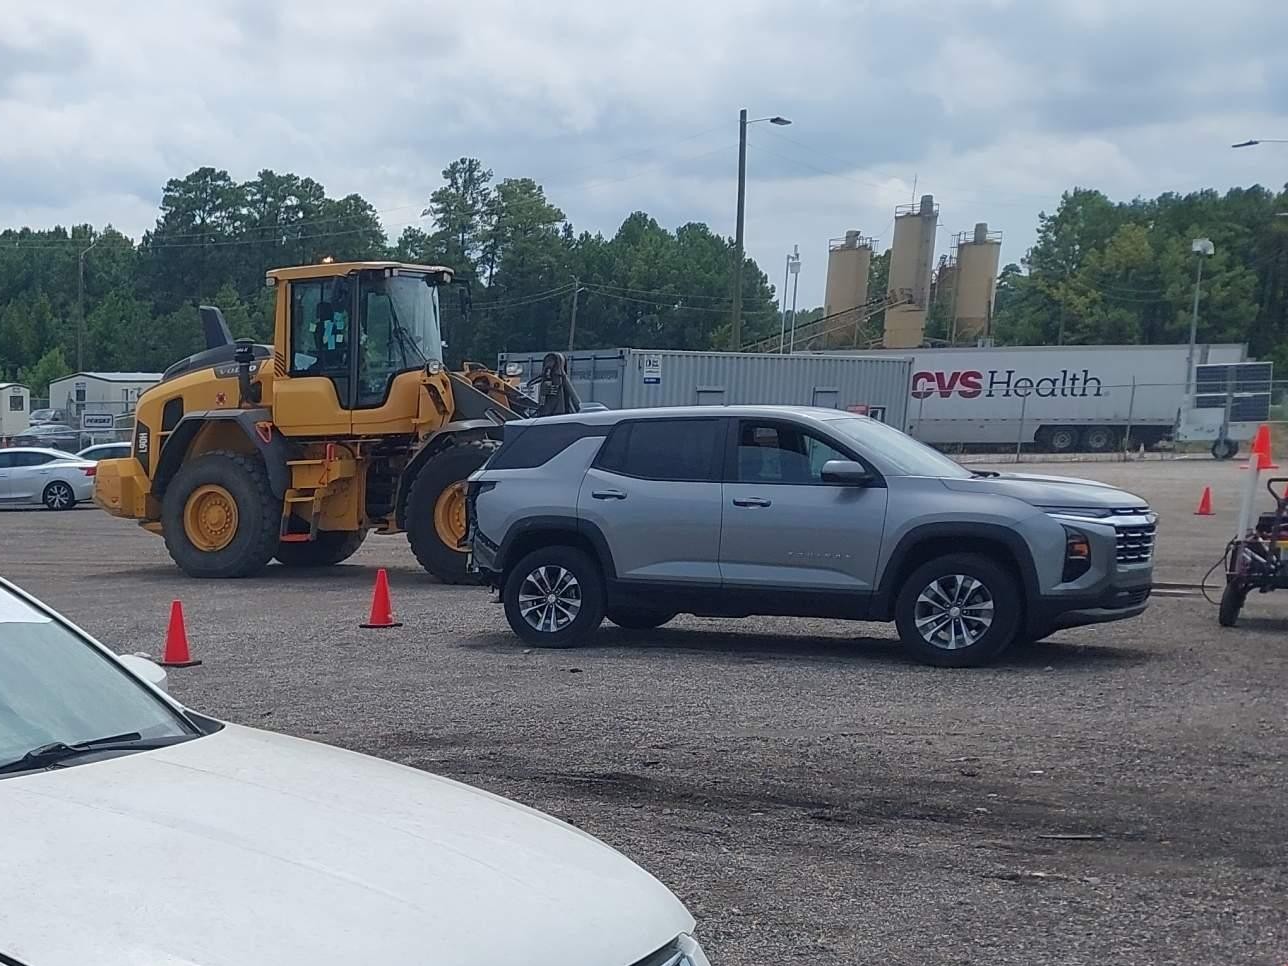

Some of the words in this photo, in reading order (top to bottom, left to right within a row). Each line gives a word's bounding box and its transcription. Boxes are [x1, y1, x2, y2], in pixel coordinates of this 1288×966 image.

[219, 365, 257, 374] VOLO
[911, 370, 983, 399] CVS
[986, 369, 1103, 398] Health
